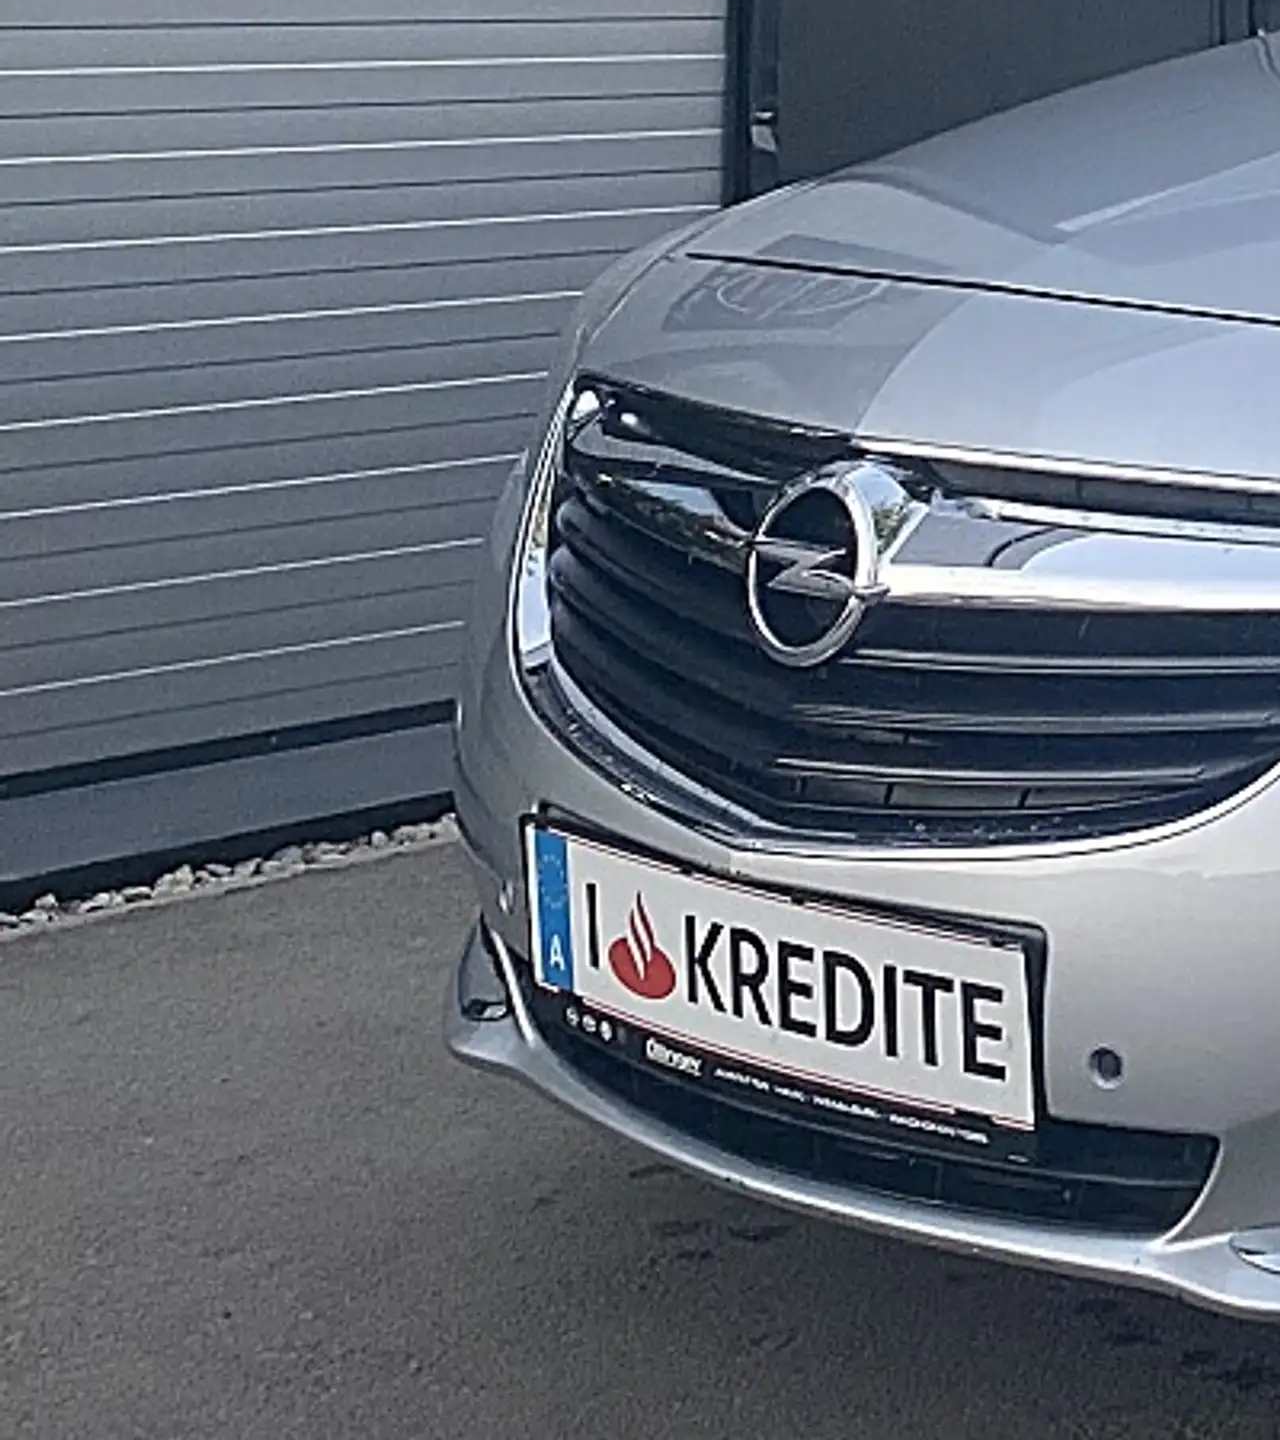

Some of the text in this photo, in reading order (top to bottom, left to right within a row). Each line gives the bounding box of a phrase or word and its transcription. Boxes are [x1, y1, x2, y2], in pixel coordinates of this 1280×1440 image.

[549, 933, 567, 973] A
[586, 882, 1007, 1083] I KREDITE
